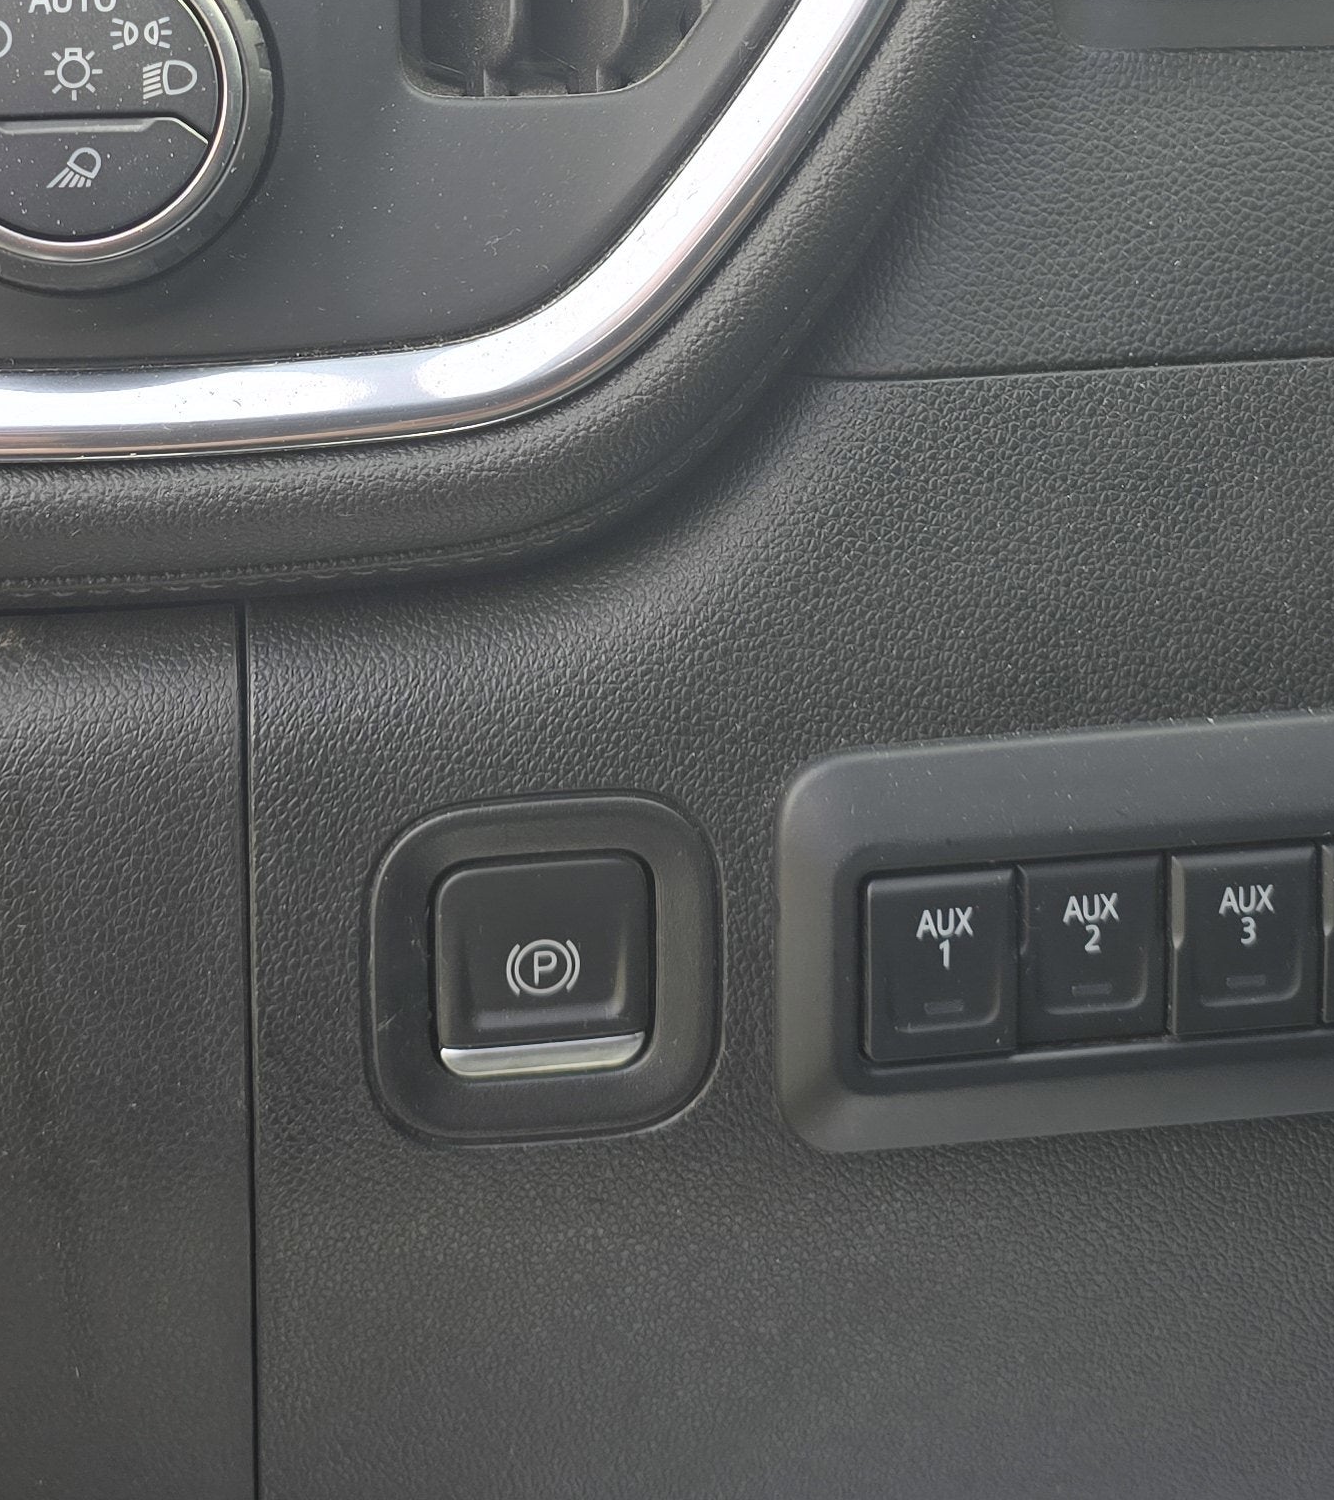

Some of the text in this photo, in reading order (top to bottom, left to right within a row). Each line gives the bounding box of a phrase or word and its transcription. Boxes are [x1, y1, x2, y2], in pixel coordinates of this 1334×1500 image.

[1062, 891, 1120, 924] AUX
[1218, 883, 1274, 916] AUX
[916, 906, 974, 939] AUX
[1240, 916, 1257, 945] 3
[939, 939, 950, 969] 1
[1084, 924, 1102, 954] 2
